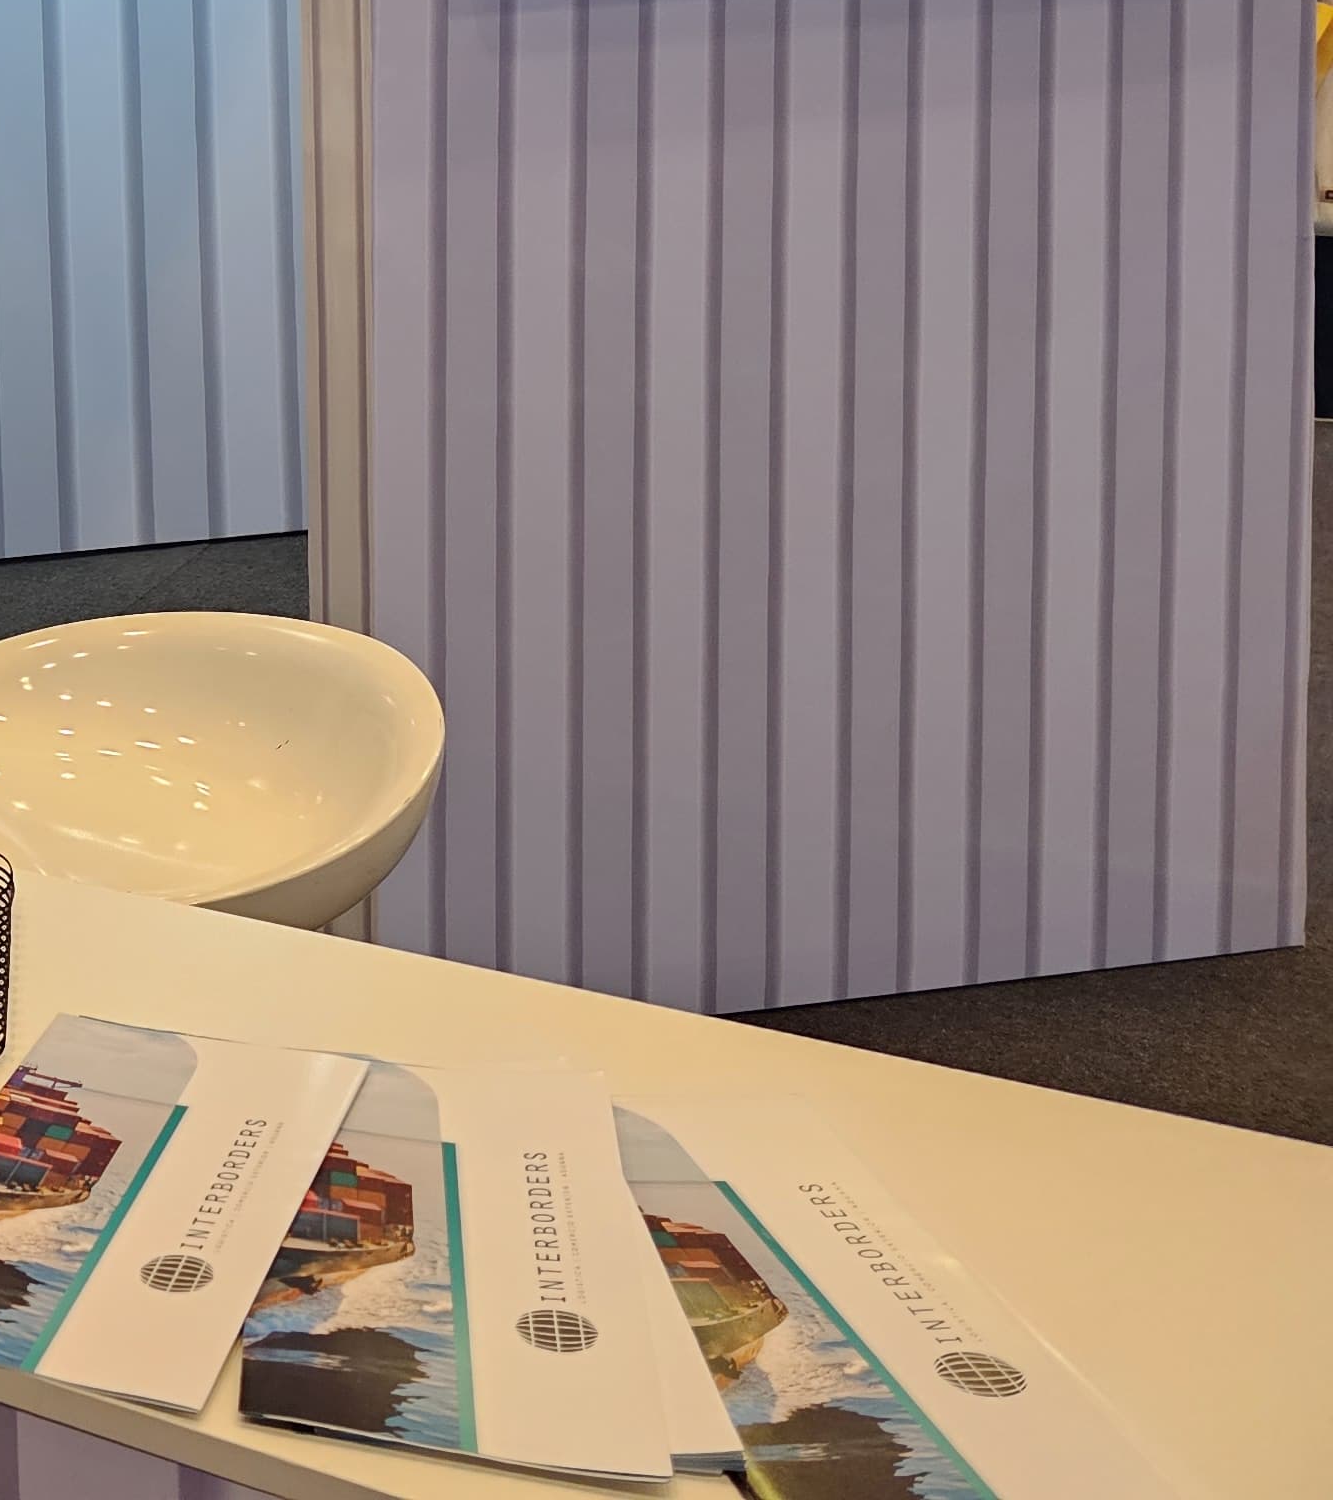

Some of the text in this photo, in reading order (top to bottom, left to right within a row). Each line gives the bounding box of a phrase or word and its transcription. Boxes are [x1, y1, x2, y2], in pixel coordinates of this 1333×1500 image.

[180, 1118, 268, 1251] INTERBORDERS
[523, 1152, 566, 1303] INTERBORDERS
[798, 1183, 962, 1344] INTERBORDERS
